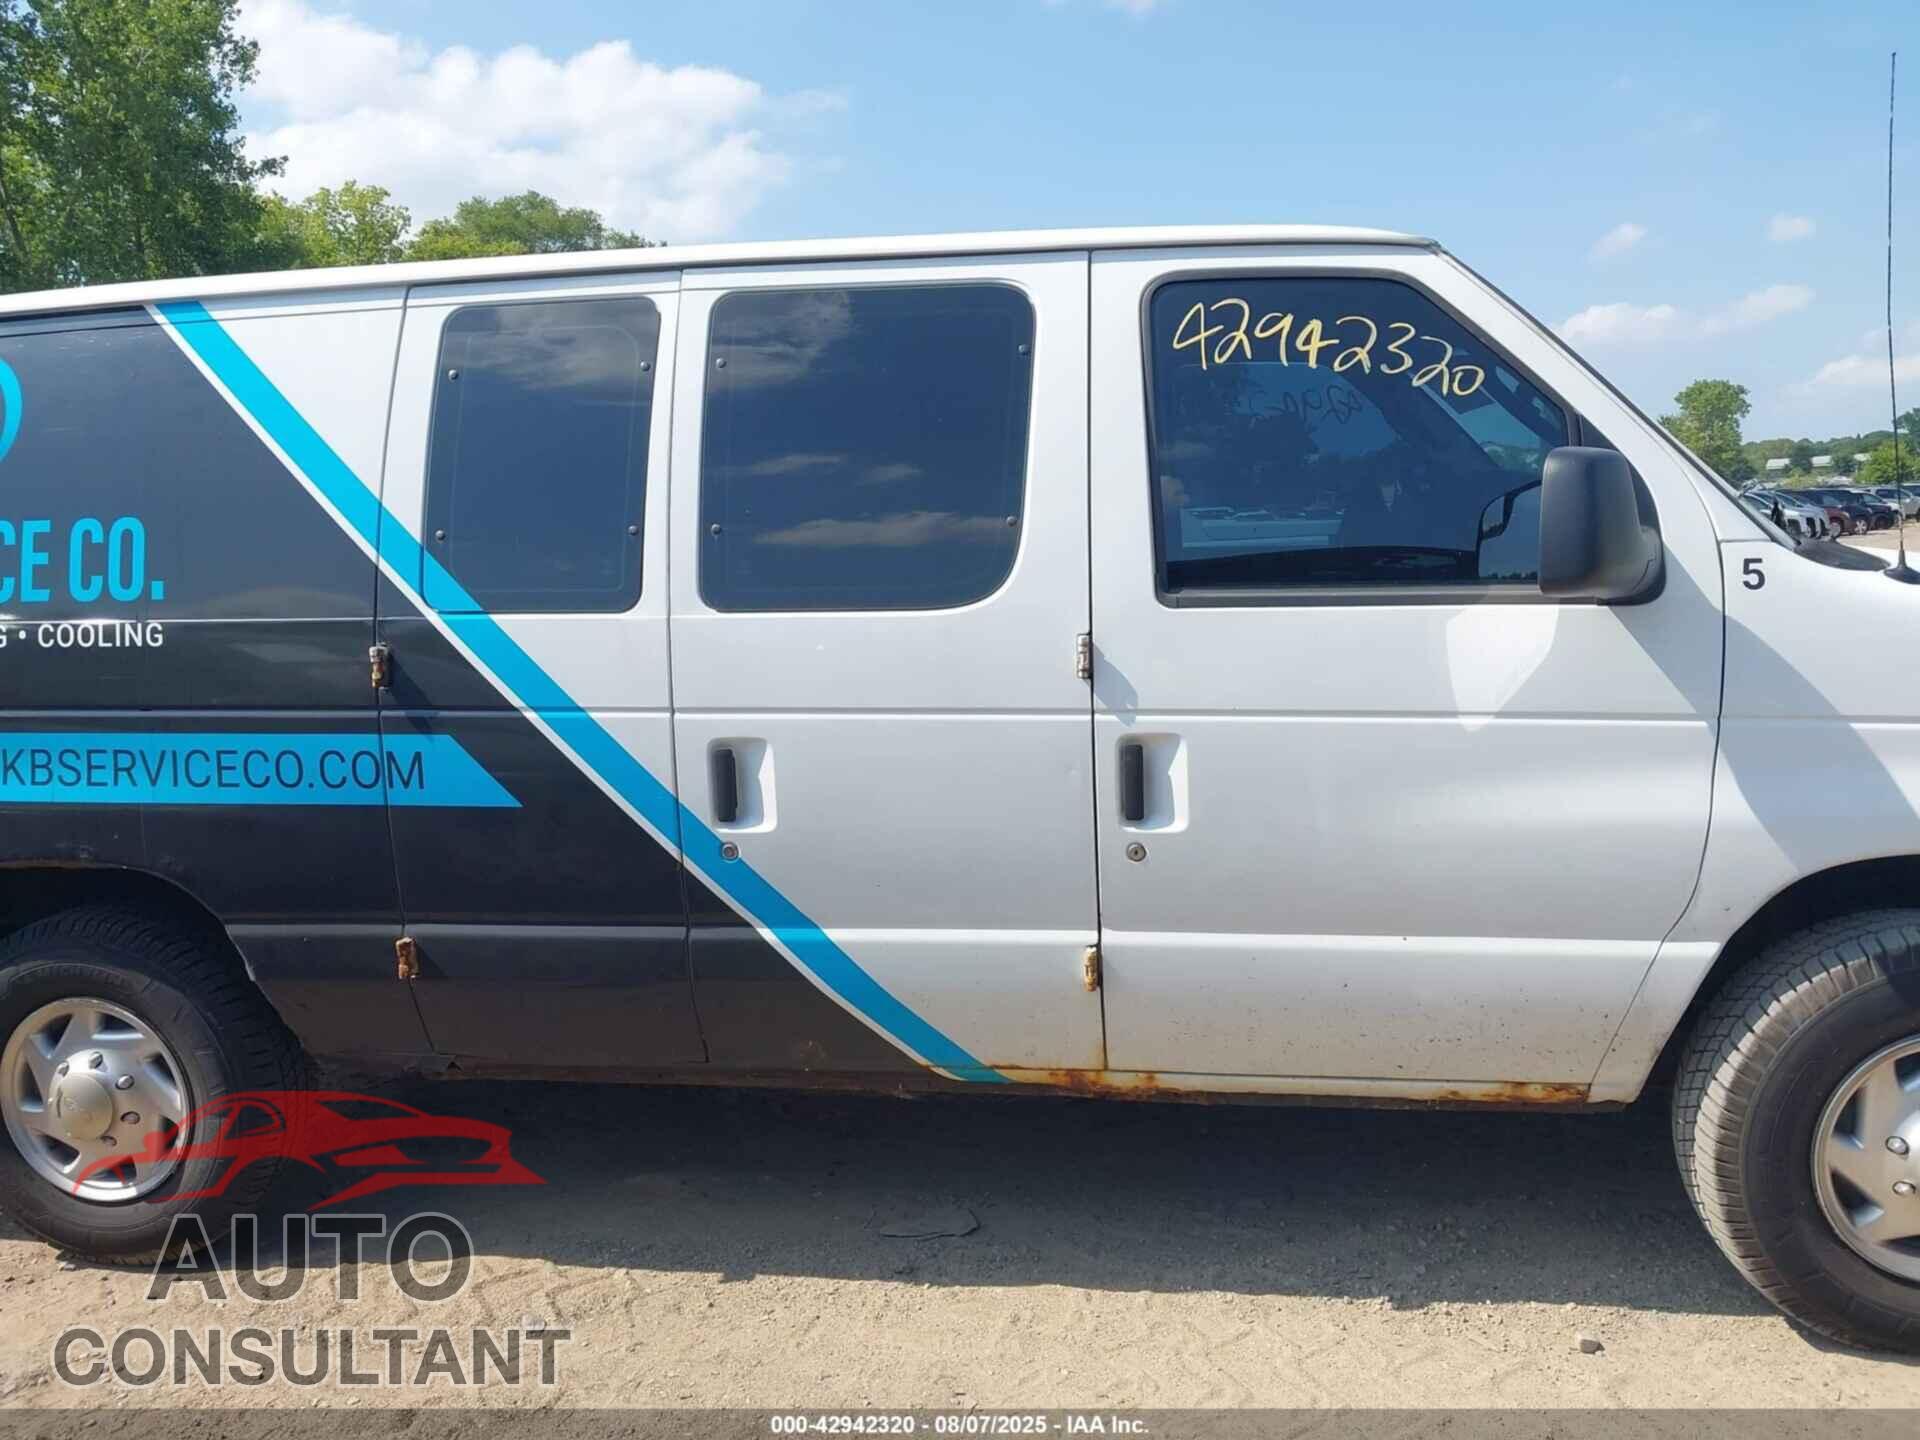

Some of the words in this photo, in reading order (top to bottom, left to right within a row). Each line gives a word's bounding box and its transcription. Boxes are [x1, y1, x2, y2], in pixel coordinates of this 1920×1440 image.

[1172, 298, 1486, 396] 42942320
[69, 516, 164, 601] CO.
[1742, 558, 1766, 590] 5
[37, 623, 164, 648] COOLING
[1, 749, 425, 789] KBSERVICECO.COM
